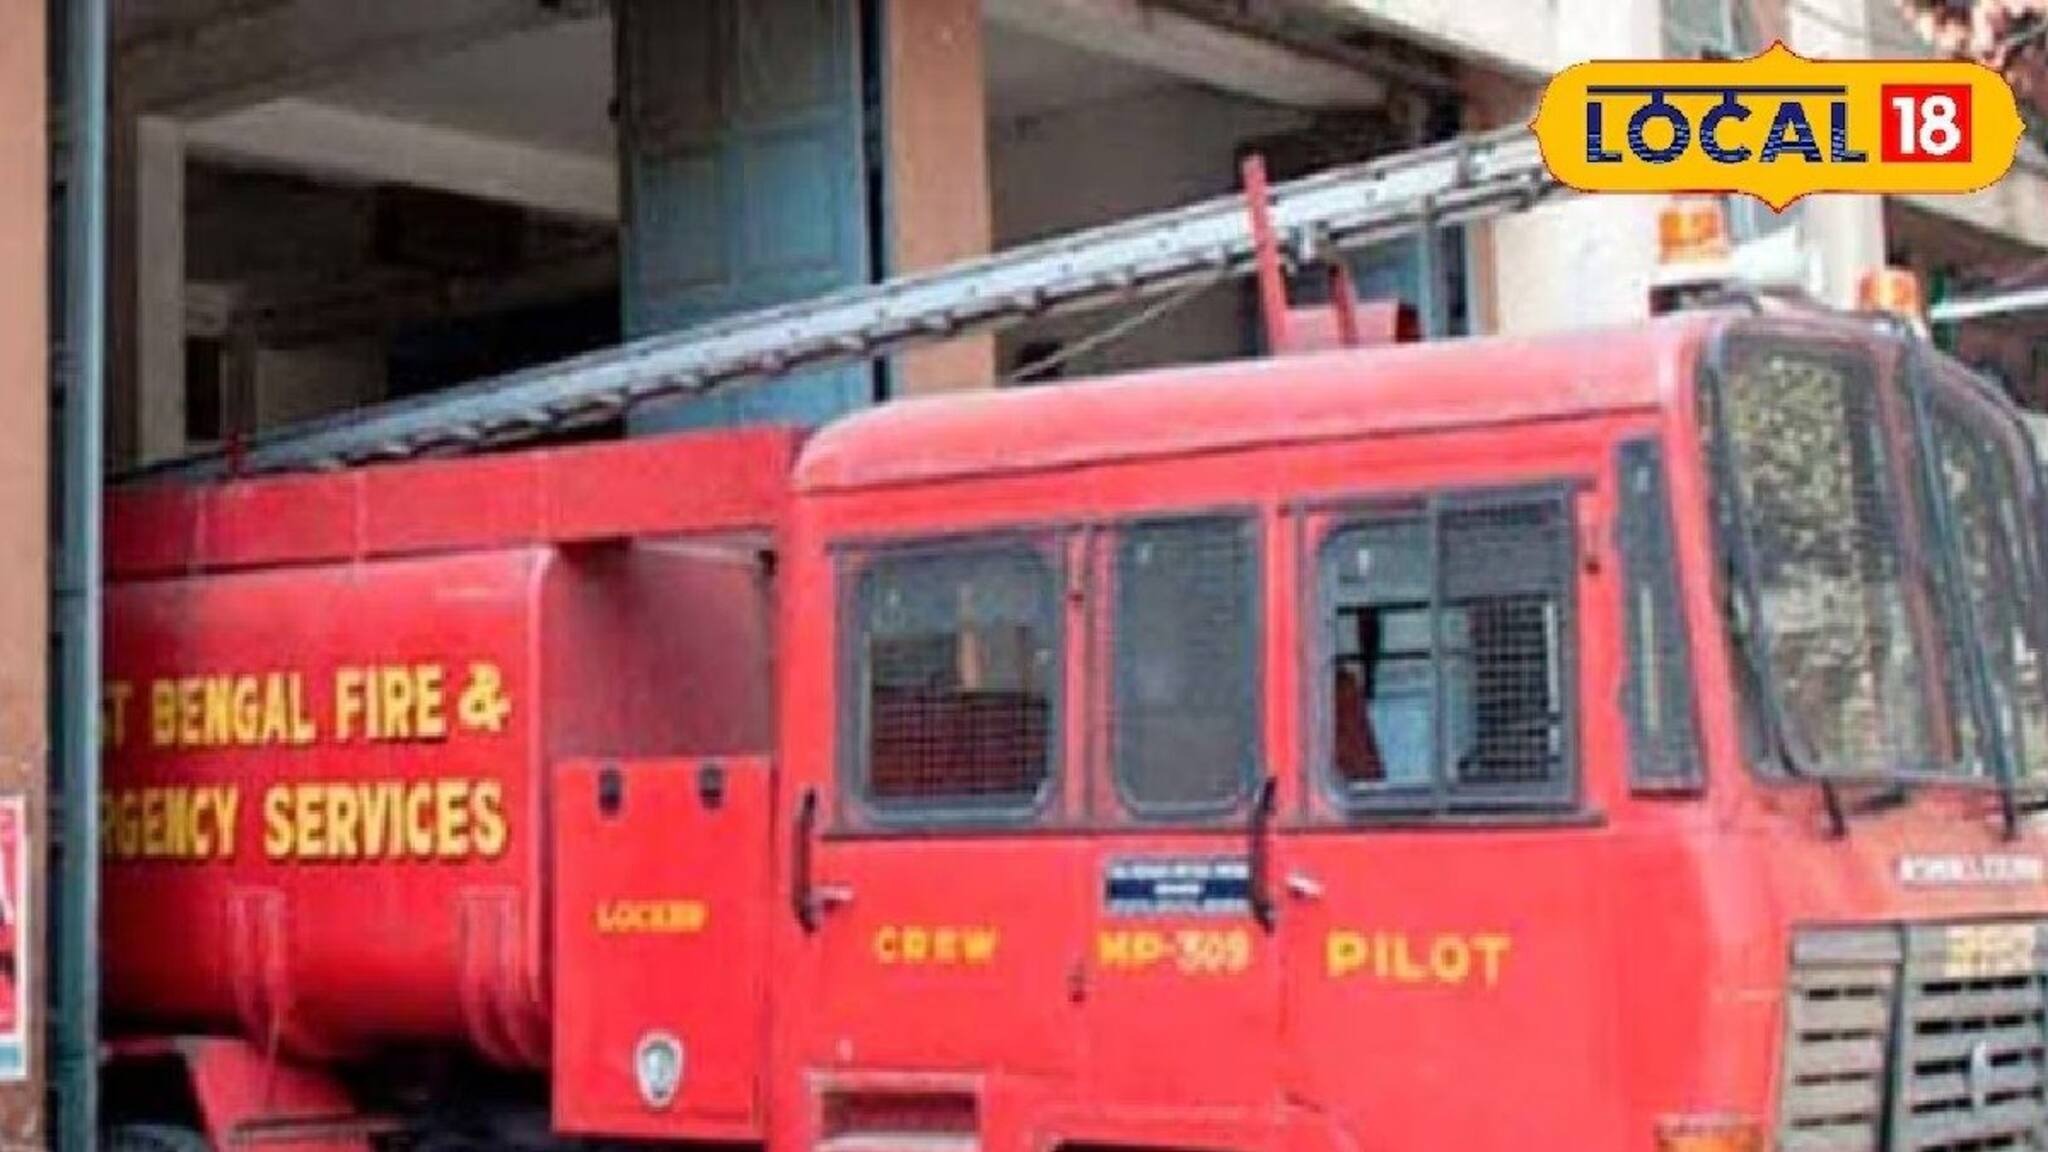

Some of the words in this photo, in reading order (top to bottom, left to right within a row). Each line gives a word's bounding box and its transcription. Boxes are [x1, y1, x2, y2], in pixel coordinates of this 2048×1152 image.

[151, 672, 316, 746] BENGAL
[335, 663, 447, 741] FIRE
[457, 660, 511, 732] &
[263, 778, 508, 861] SERVICES
[875, 924, 997, 966] CREW
[1326, 929, 1511, 986] PILOT
